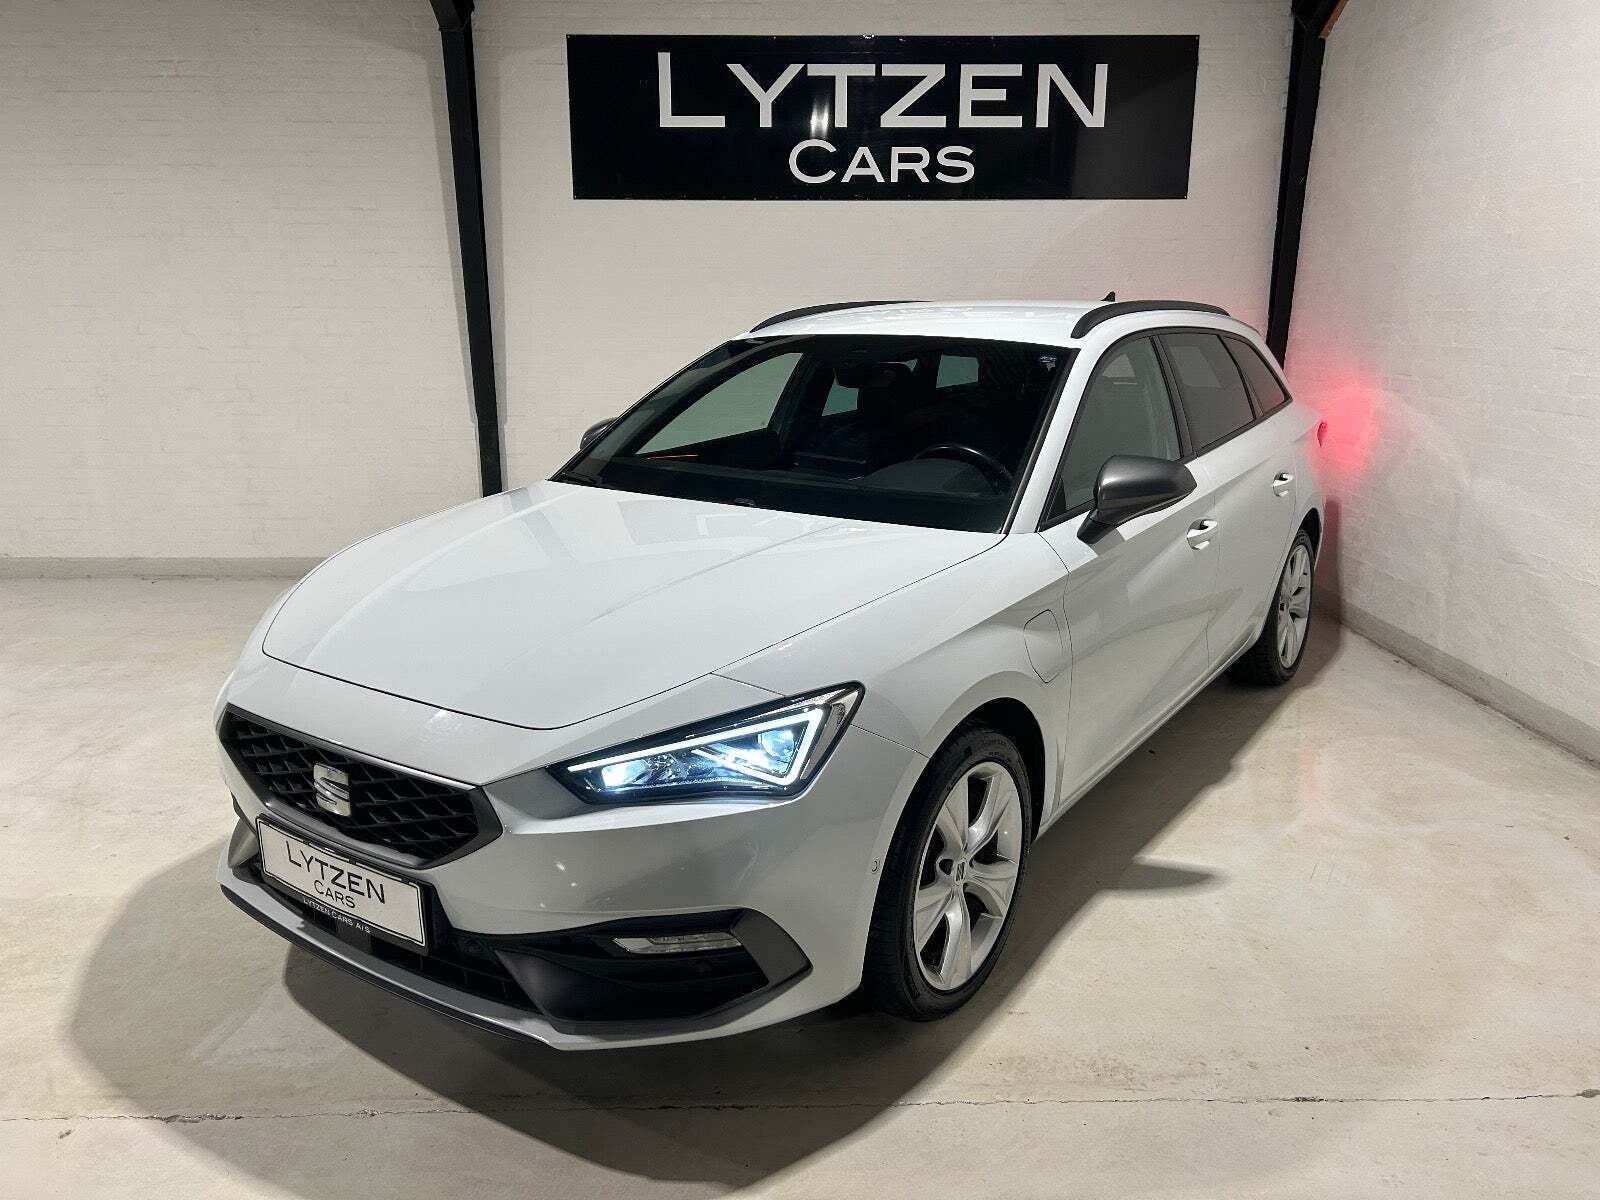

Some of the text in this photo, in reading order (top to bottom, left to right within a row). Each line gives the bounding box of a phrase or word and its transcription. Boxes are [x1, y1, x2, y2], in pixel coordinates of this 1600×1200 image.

[657, 51, 1109, 129] LYTZEN
[788, 138, 975, 185] CARS
[285, 840, 386, 905] LYTZEN
[313, 879, 356, 909] CARS
[331, 911, 353, 926] CARS
